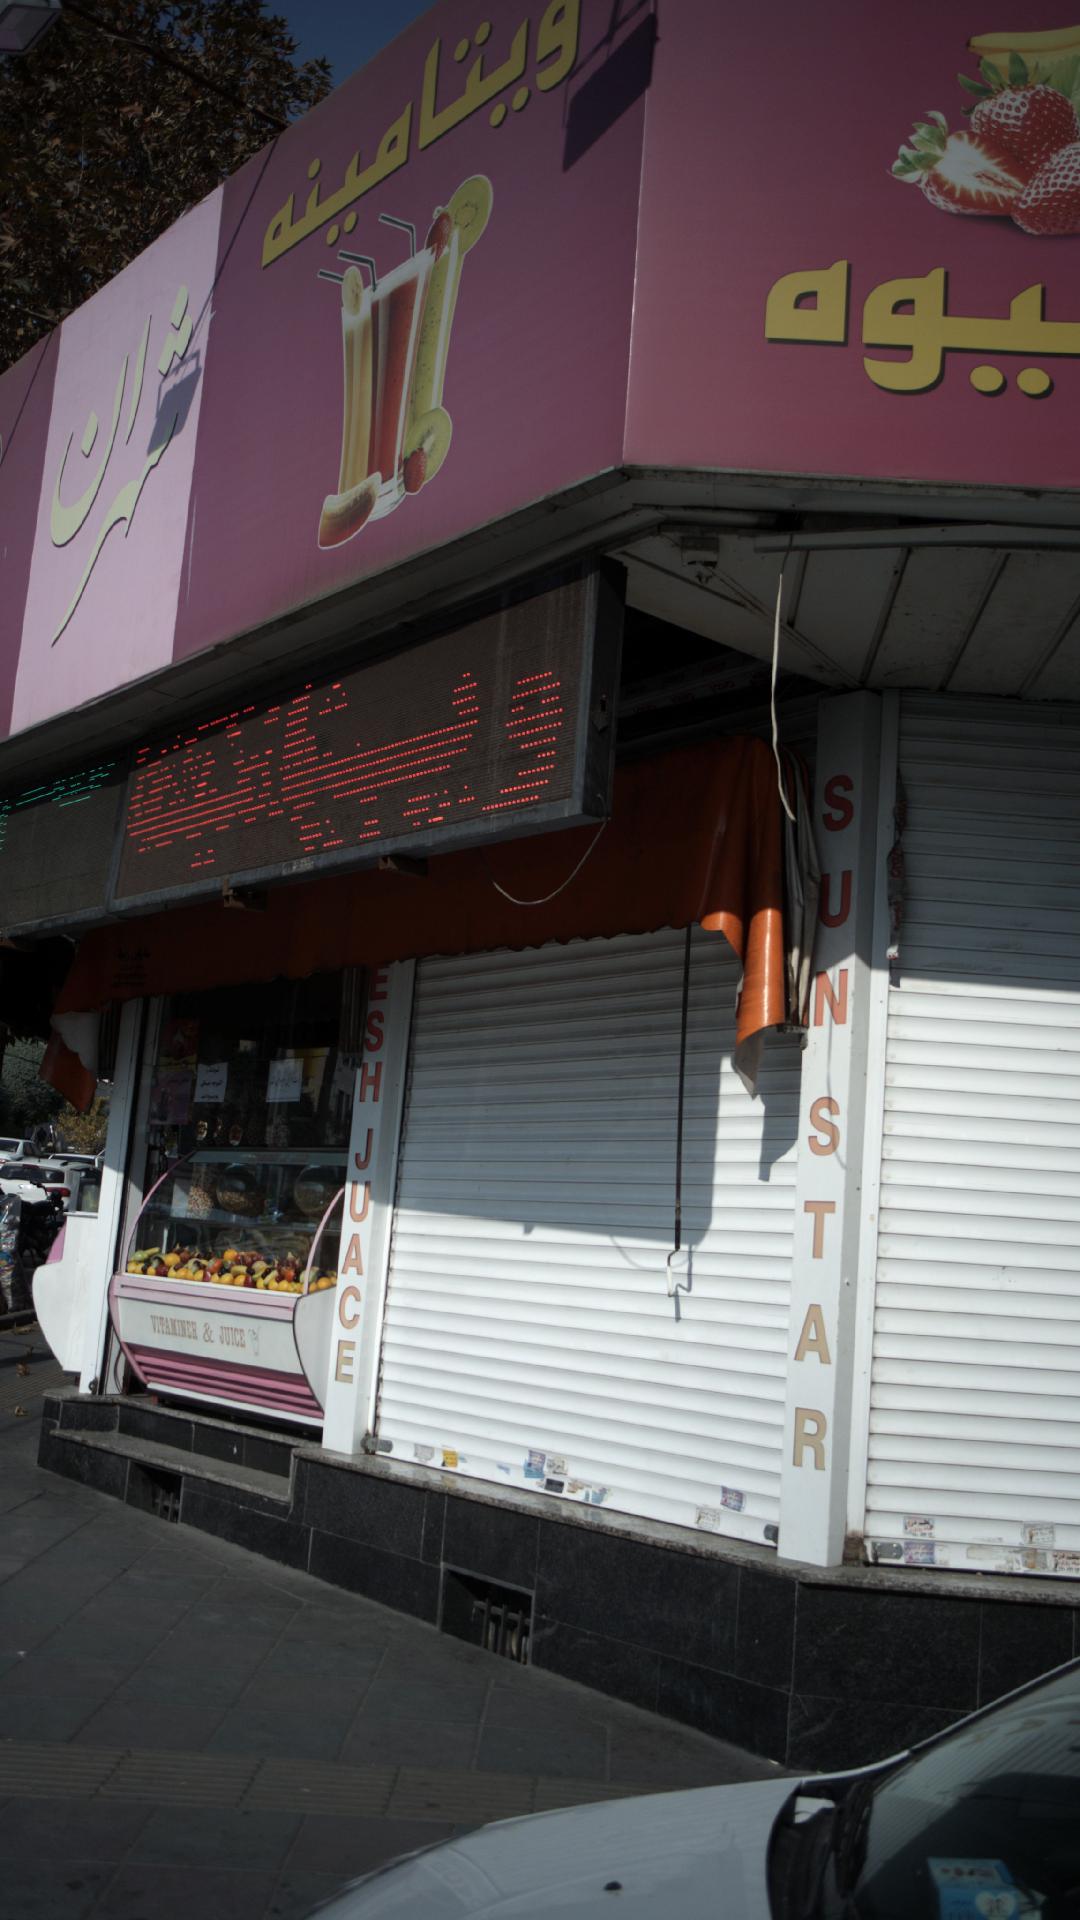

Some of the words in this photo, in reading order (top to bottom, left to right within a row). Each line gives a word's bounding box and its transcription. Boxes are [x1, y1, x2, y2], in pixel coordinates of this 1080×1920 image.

[262, 0, 580, 269] ویتامینه
[765, 260, 1080, 396] یوه
[202, 1322, 214, 1343] &
[219, 1326, 246, 1348] JUICE
[334, 1128, 374, 1383] JUACE
